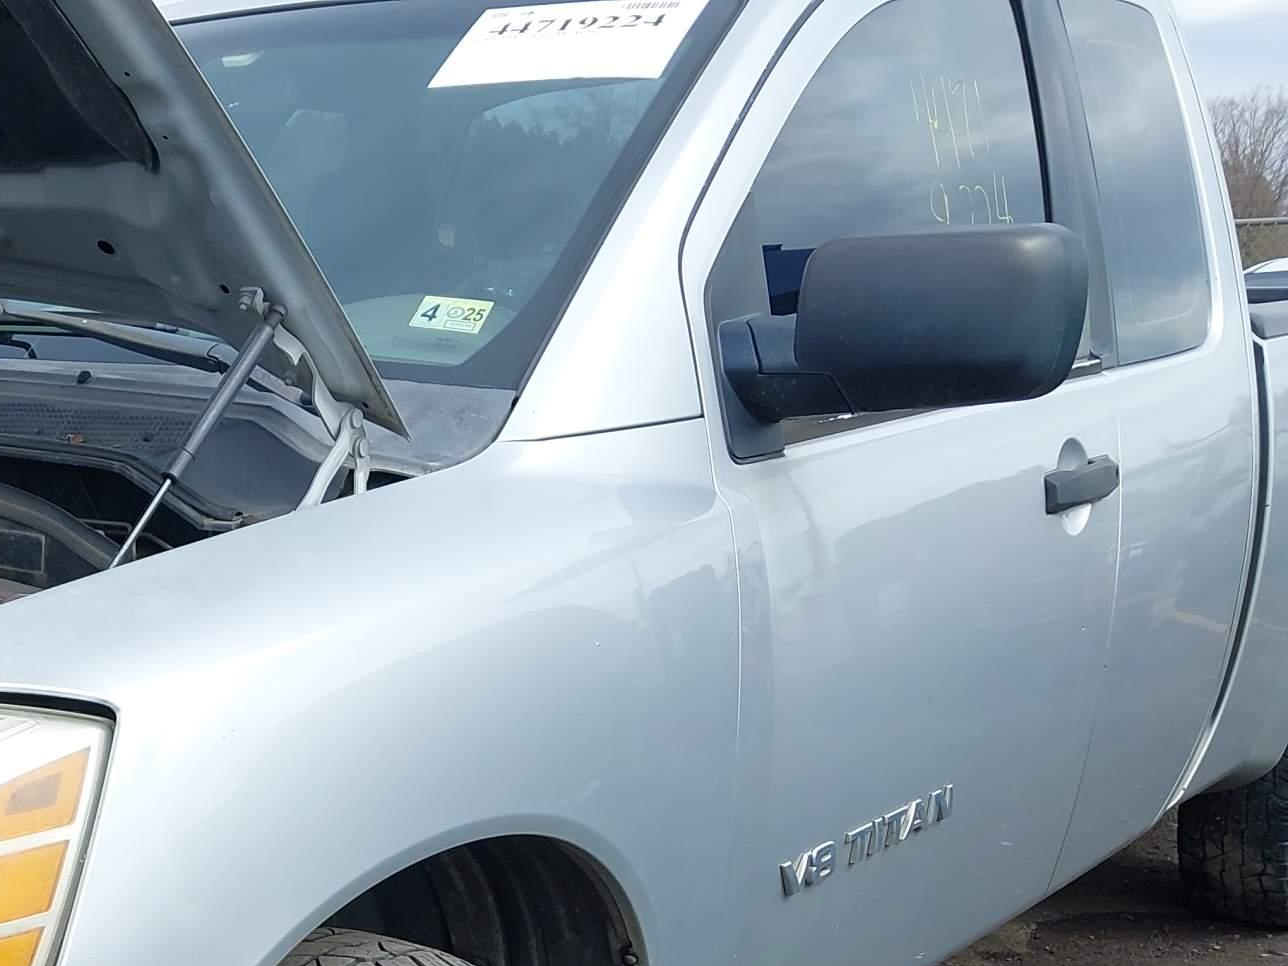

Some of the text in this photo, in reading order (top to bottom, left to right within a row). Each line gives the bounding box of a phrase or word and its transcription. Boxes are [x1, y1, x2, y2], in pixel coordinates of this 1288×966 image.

[488, 13, 667, 36] 44719224
[420, 303, 486, 322] 4 25
[779, 783, 954, 897] V8 TITAN
